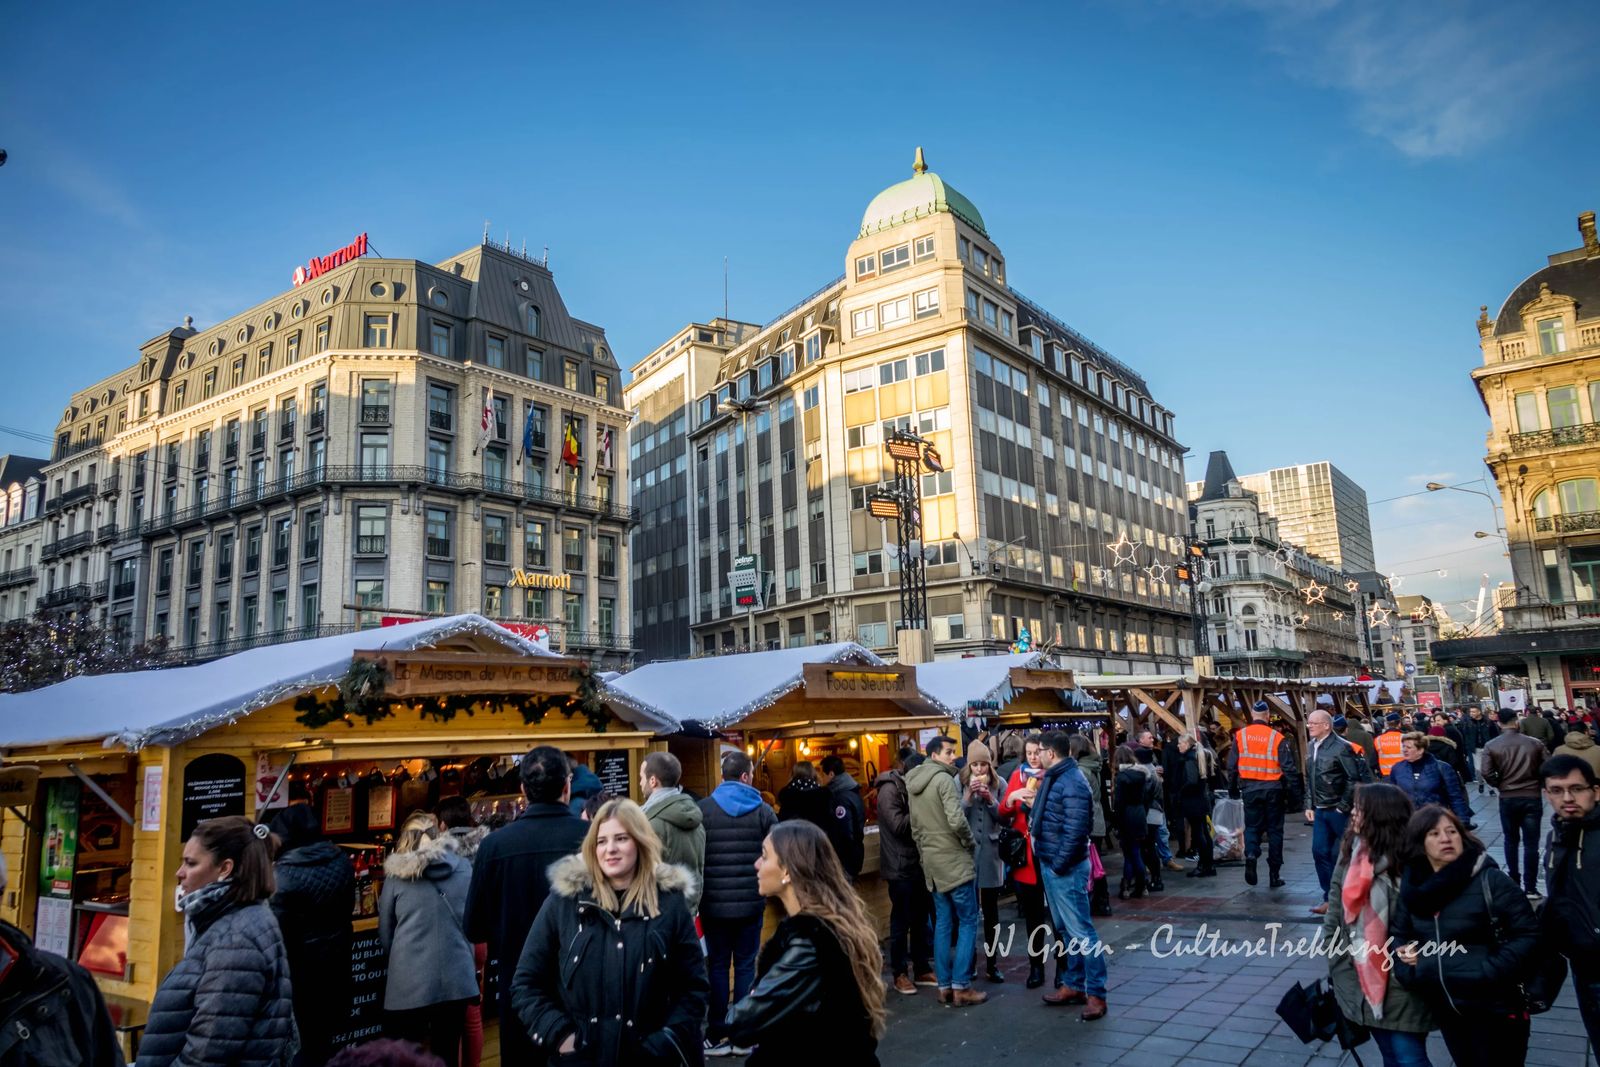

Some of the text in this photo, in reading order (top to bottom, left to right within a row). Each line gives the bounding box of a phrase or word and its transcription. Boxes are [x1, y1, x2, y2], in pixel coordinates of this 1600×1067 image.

[305, 231, 368, 283] Marriott
[507, 567, 571, 590] Marriott
[393, 660, 569, 682] La Maison du Vin Chaud
[826, 669, 856, 691] Food
[357, 939, 373, 949] VIN
[368, 970, 382, 980] OU
